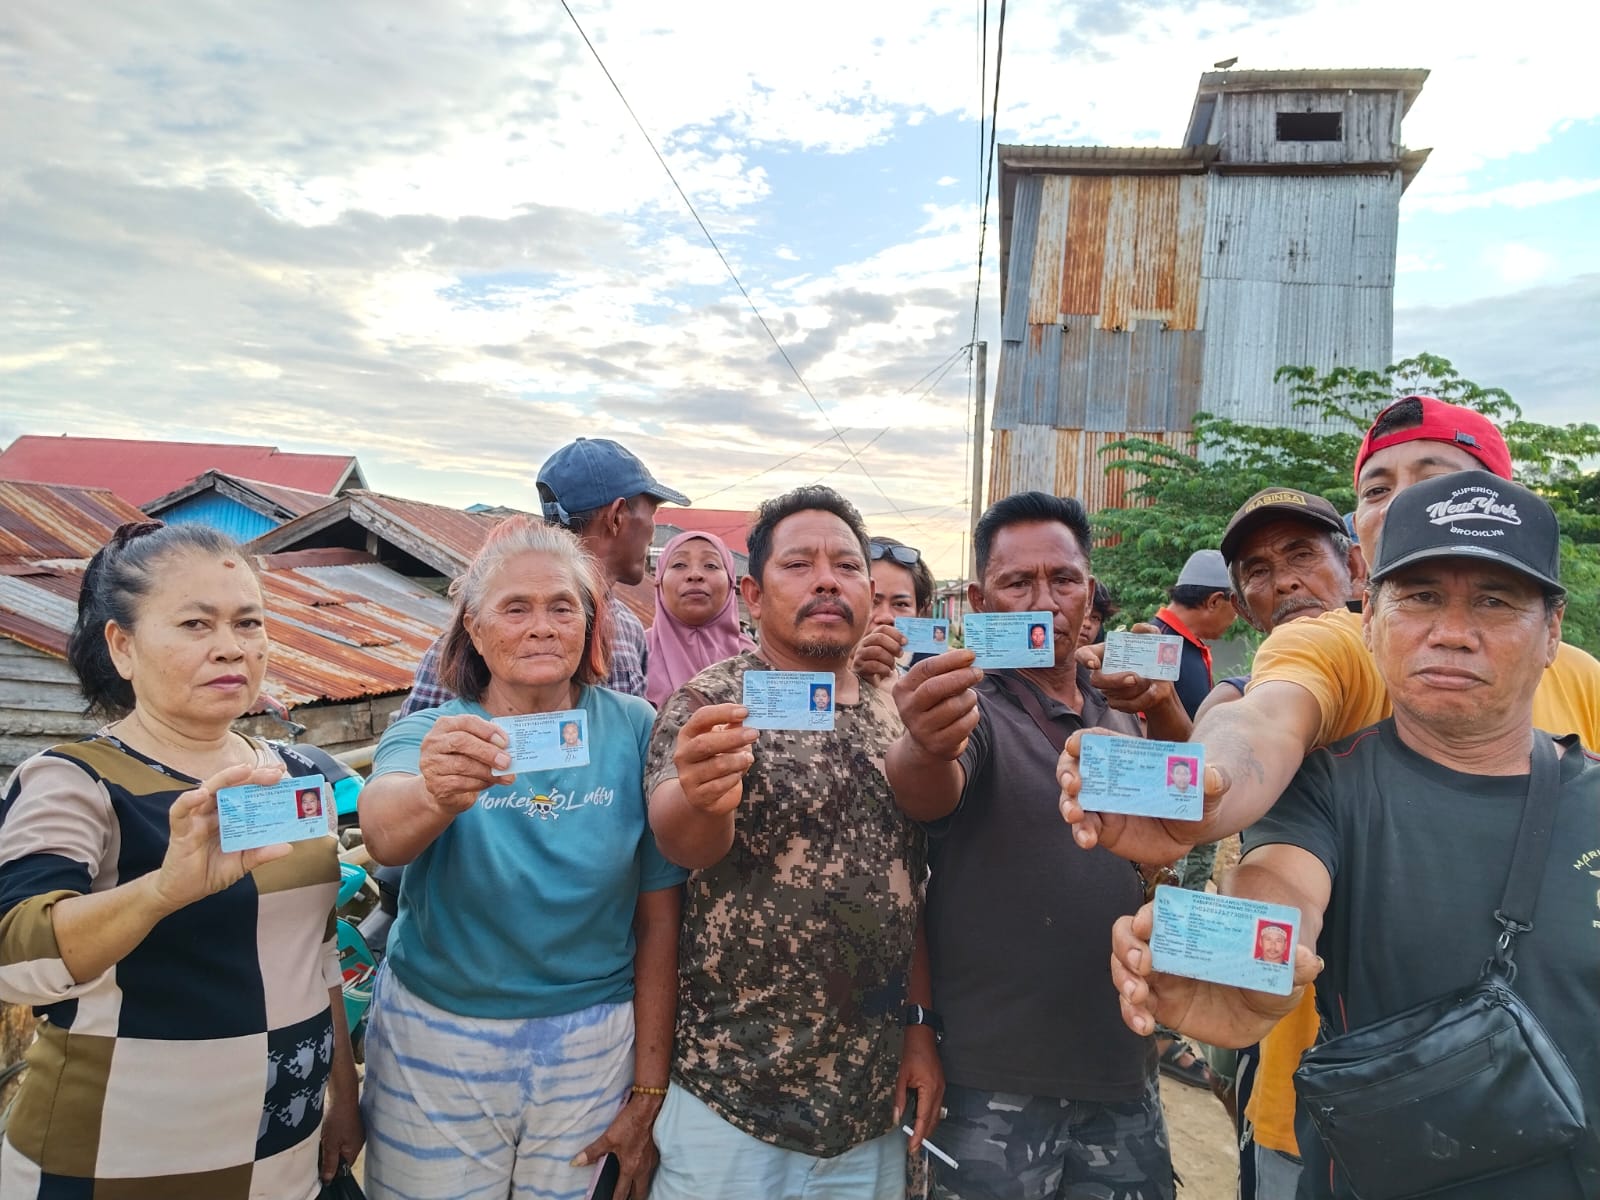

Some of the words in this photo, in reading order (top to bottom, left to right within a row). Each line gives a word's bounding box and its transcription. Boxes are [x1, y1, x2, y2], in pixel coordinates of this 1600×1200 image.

[1452, 486, 1499, 498] SUPERIOR
[1426, 499, 1475, 518] New
[1471, 496, 1517, 518] York
[1450, 526, 1504, 537] BROOKLYN
